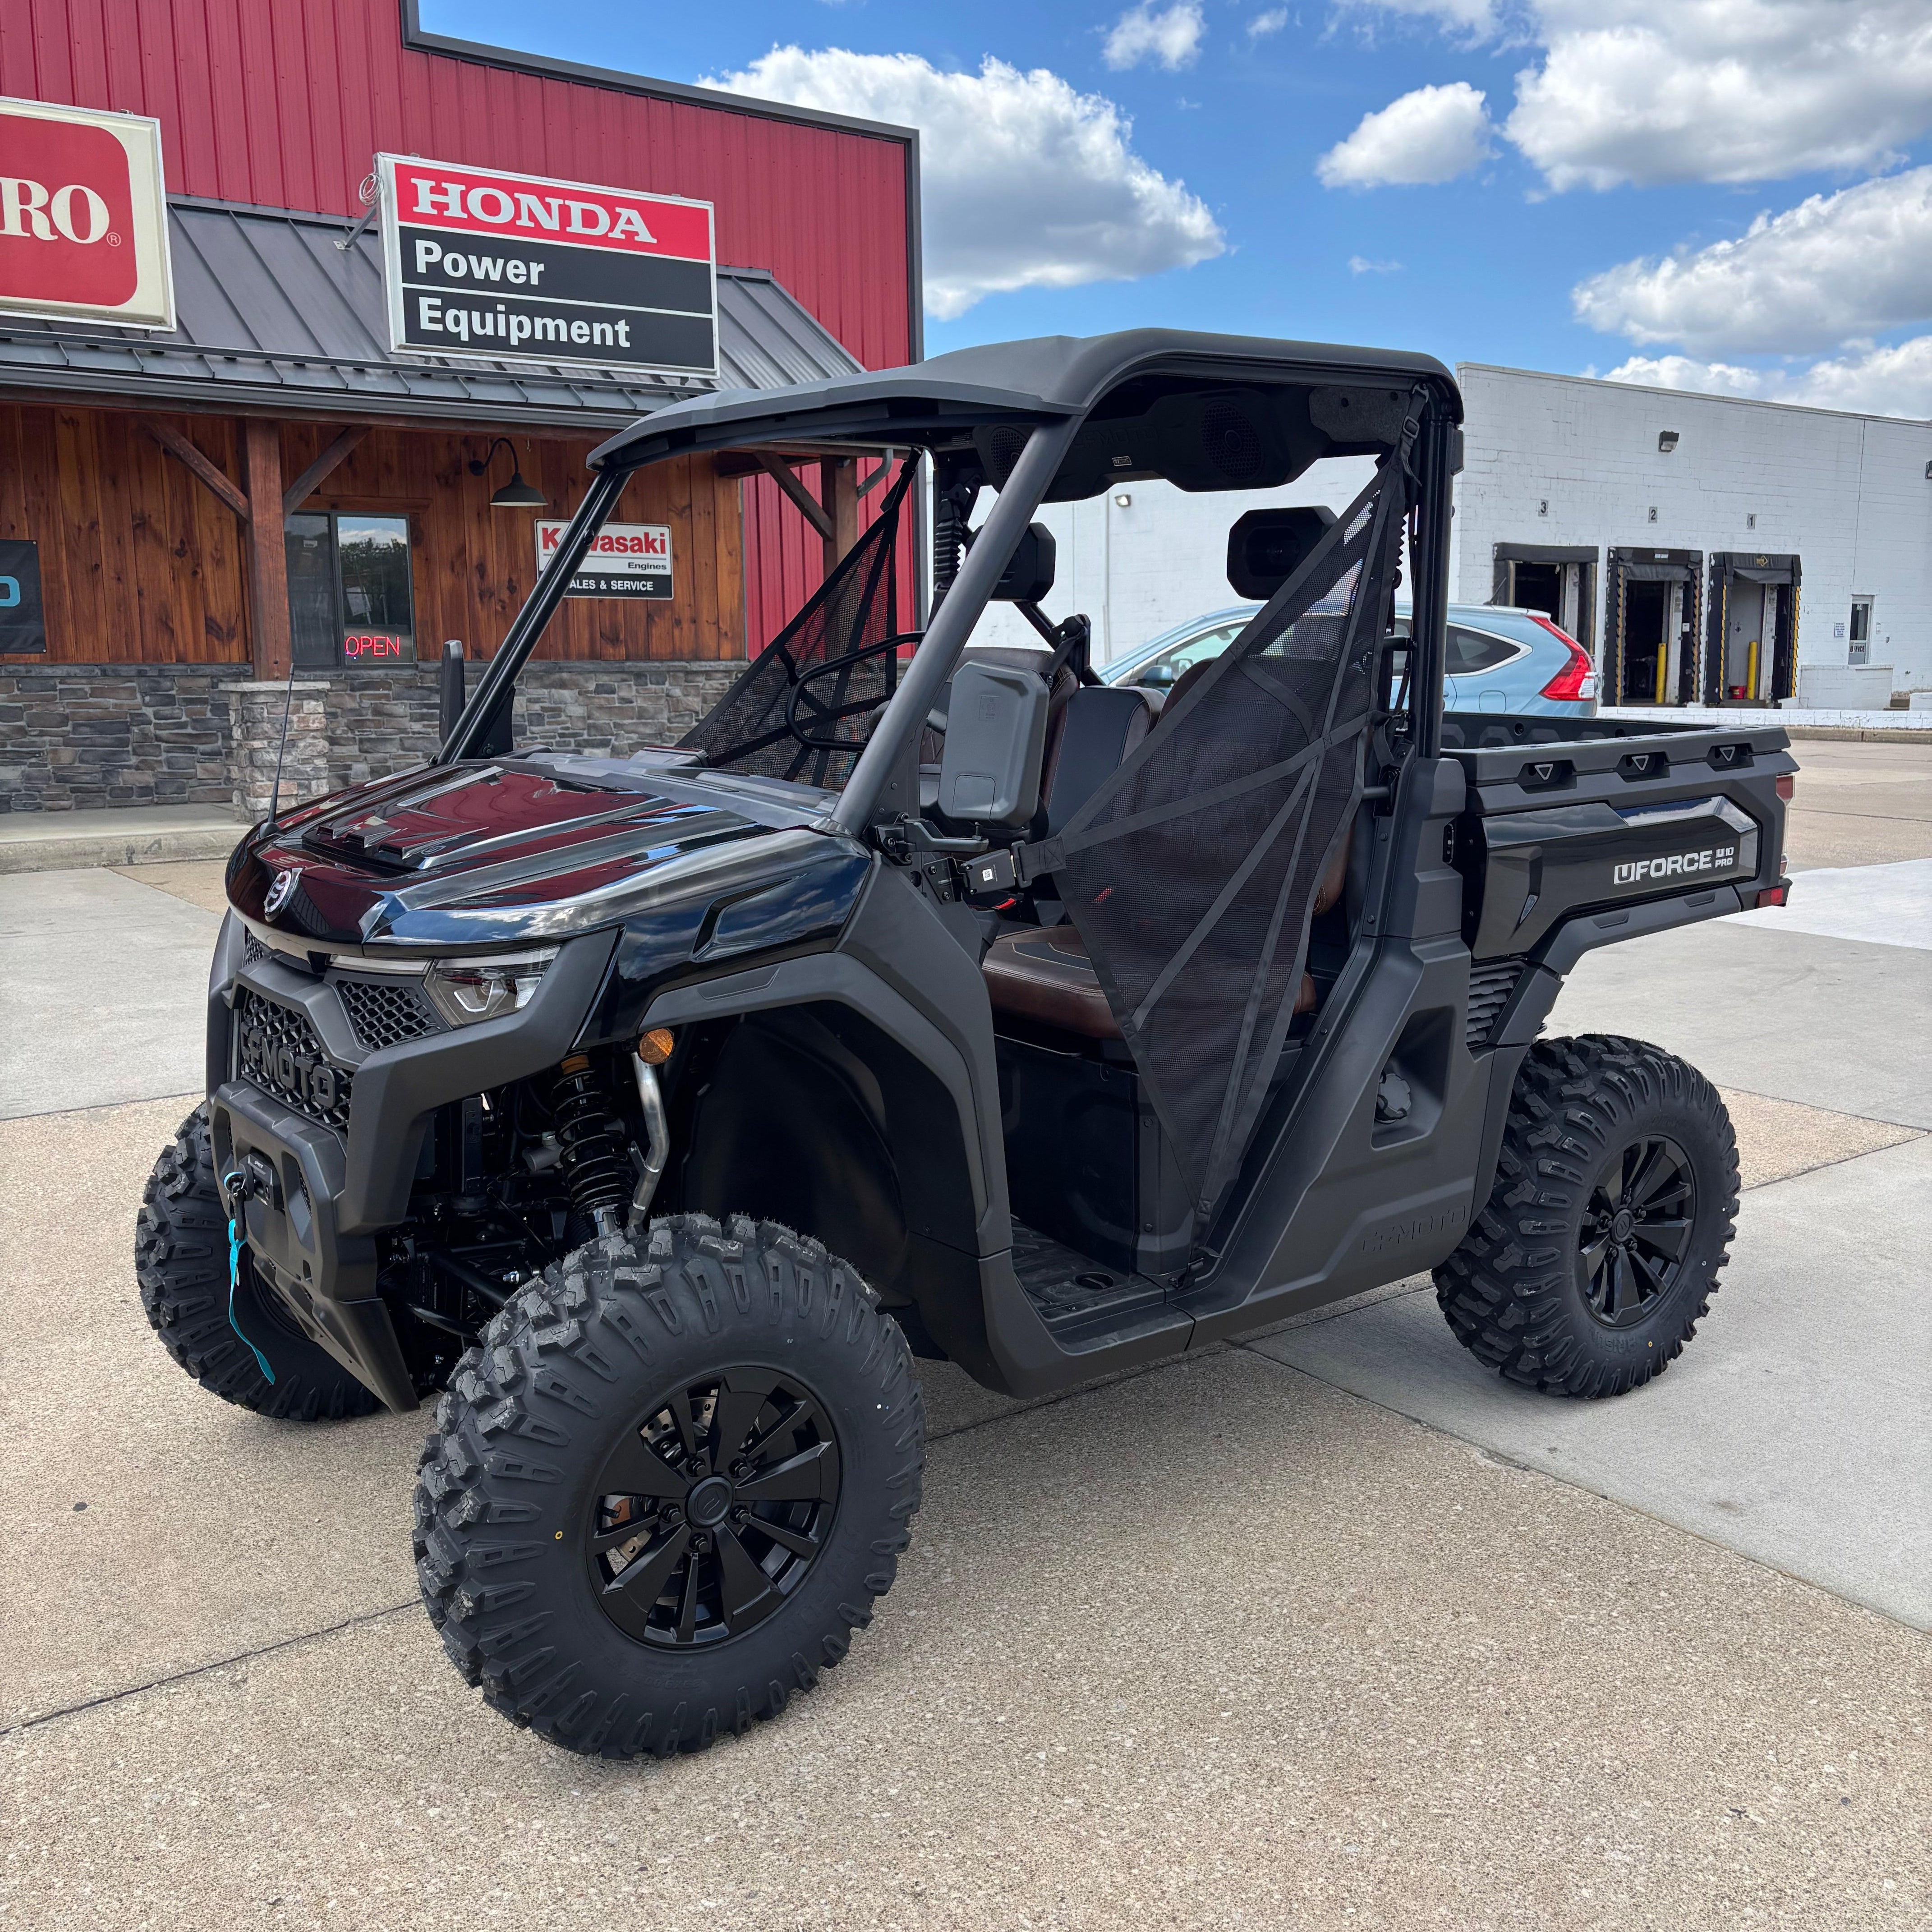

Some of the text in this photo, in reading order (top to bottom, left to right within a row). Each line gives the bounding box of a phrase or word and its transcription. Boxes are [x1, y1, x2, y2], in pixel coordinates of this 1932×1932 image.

[410, 178, 657, 244] HONDA
[415, 239, 545, 285] Power
[419, 296, 631, 348] Equipment
[1540, 501, 1547, 514] 3
[1651, 509, 1656, 520] 2
[1749, 516, 1754, 526] 1
[542, 527, 667, 554] Kasaki
[628, 562, 667, 570] Engines
[570, 580, 653, 591] ALES & SERVICE
[345, 636, 400, 657] OPEN
[1614, 850, 1713, 884] UFORCE
[1715, 857, 1733, 868] PRO
[241, 1021, 336, 1109] CFMOTO
